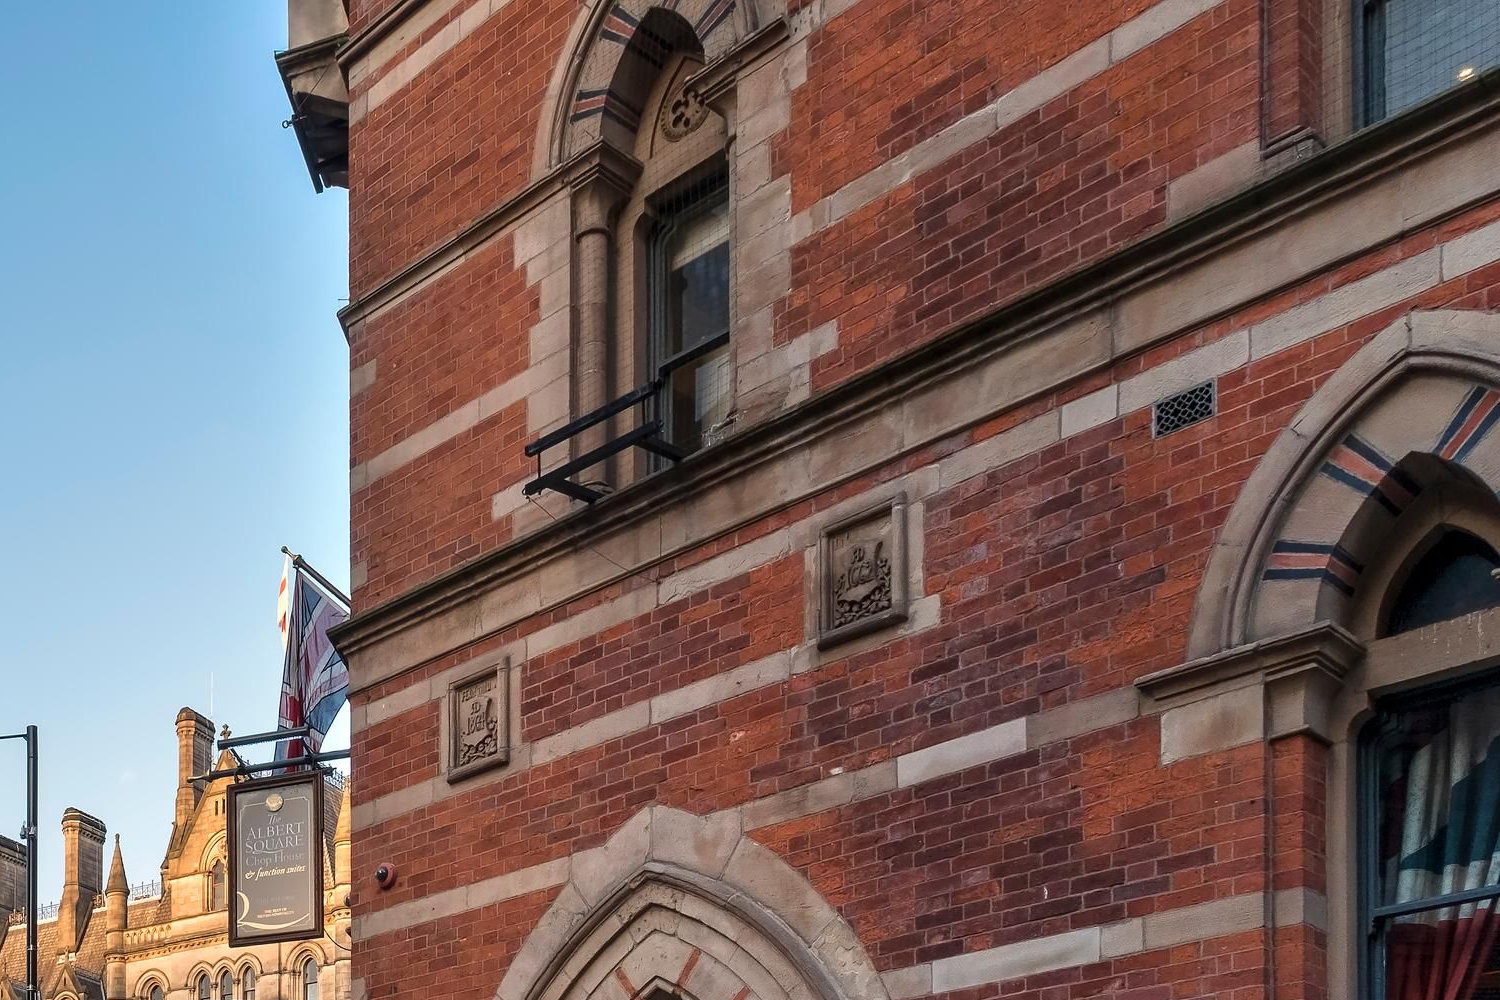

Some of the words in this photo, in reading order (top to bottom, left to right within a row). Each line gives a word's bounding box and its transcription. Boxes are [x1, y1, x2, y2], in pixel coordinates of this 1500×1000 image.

[267, 813, 282, 826] The
[246, 821, 305, 841] ALBERT
[245, 834, 305, 855] SQUARE
[245, 855, 272, 868] Chop
[273, 849, 305, 864] House
[244, 870, 256, 880] &
[255, 866, 286, 881] function
[286, 864, 306, 875] suites
